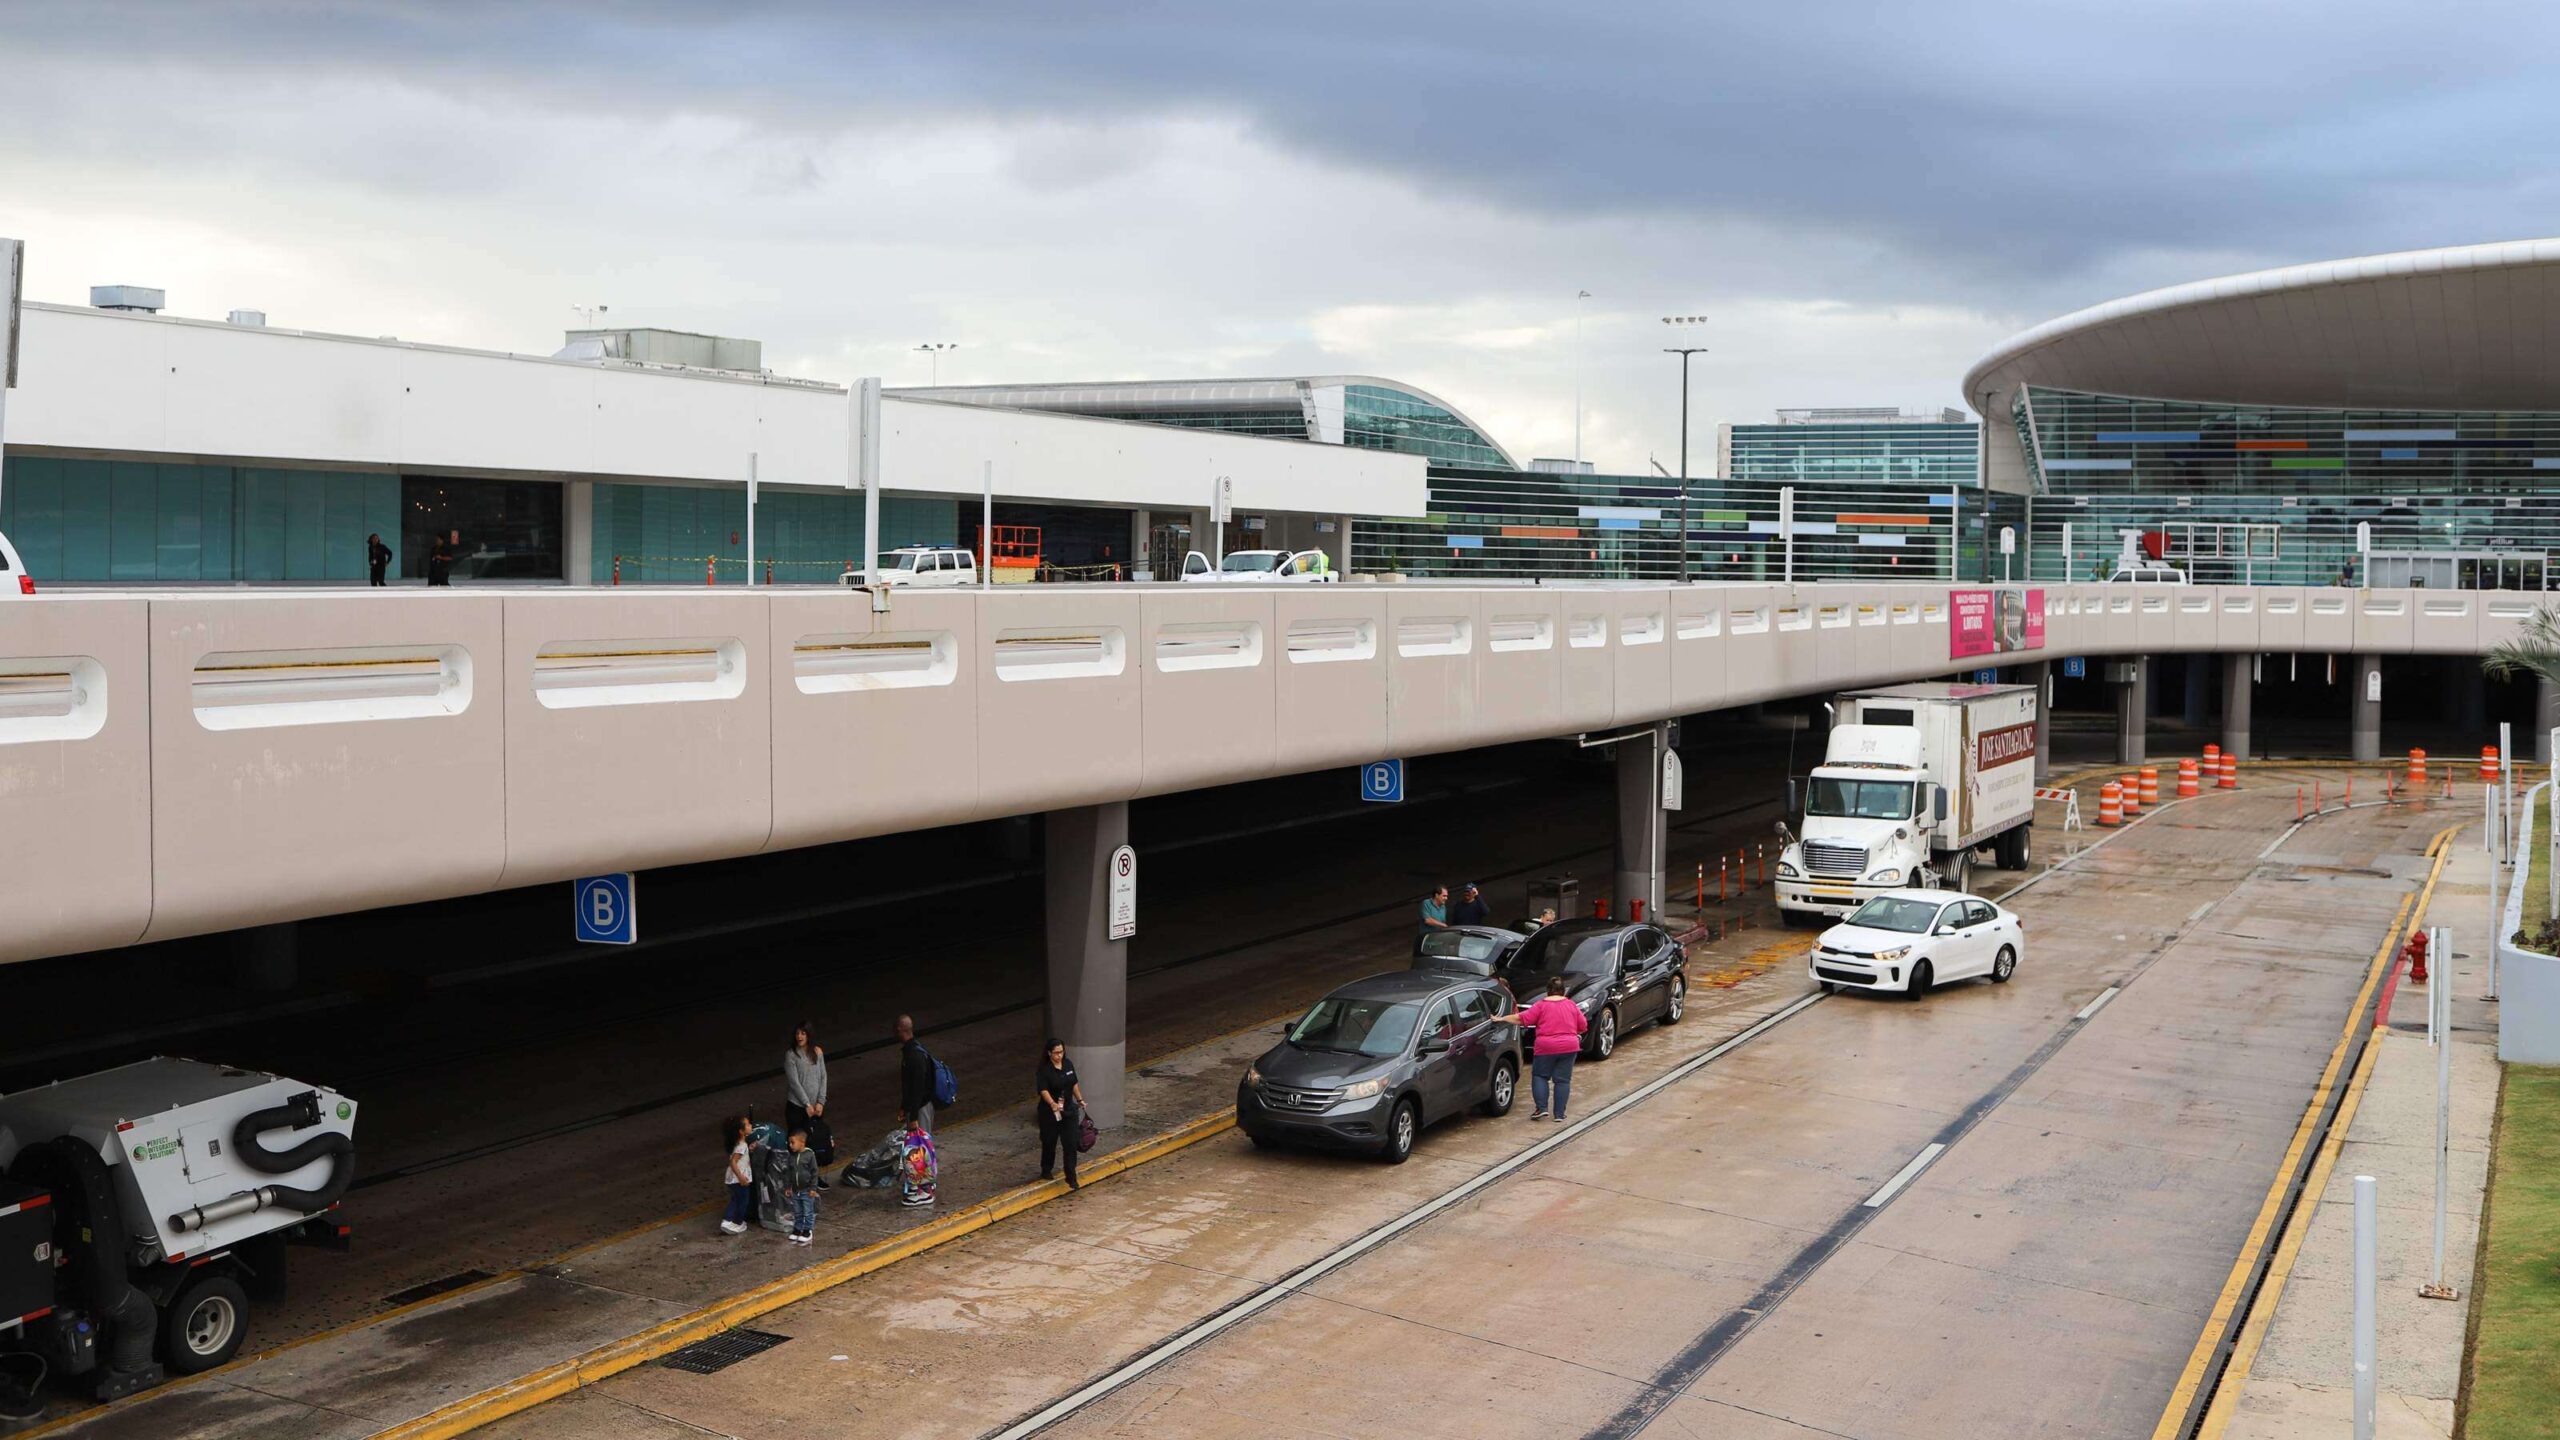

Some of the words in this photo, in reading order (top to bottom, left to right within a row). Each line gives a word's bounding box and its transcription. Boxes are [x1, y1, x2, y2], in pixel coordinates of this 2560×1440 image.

[2070, 661, 2079, 672] B
[1981, 672, 1990, 684] B
[1375, 767, 1390, 791] B
[593, 887, 614, 926] B
[146, 1136, 169, 1148] PERFECT
[147, 1141, 178, 1154] INTEGRATED
[148, 1148, 177, 1161] SOLUTIONS
